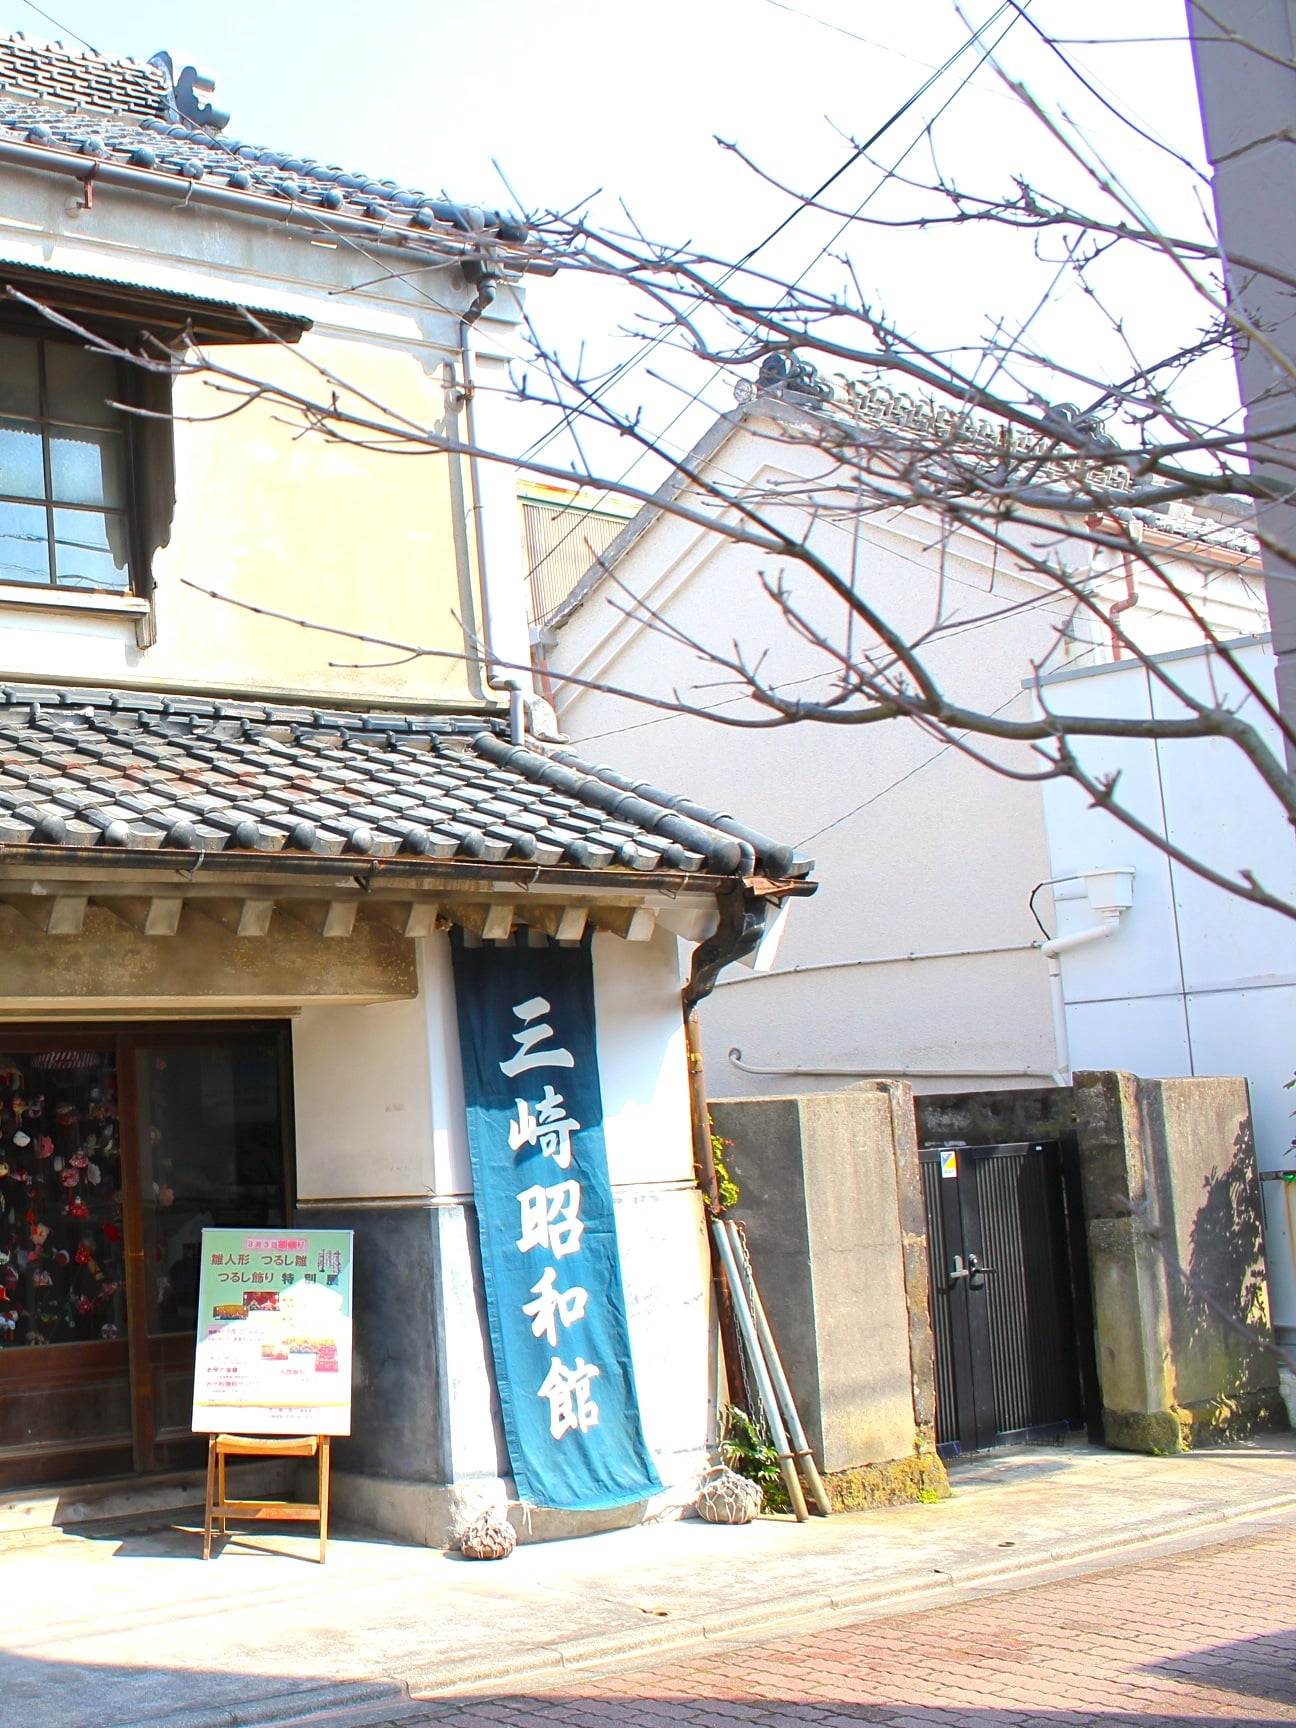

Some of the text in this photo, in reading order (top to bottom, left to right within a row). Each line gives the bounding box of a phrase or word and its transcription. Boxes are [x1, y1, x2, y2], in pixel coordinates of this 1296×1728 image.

[499, 996, 602, 1441] 三崎昭和館
[211, 1253, 307, 1267] 雛人形 つるし雛
[217, 1271, 274, 1284] つるし飾り
